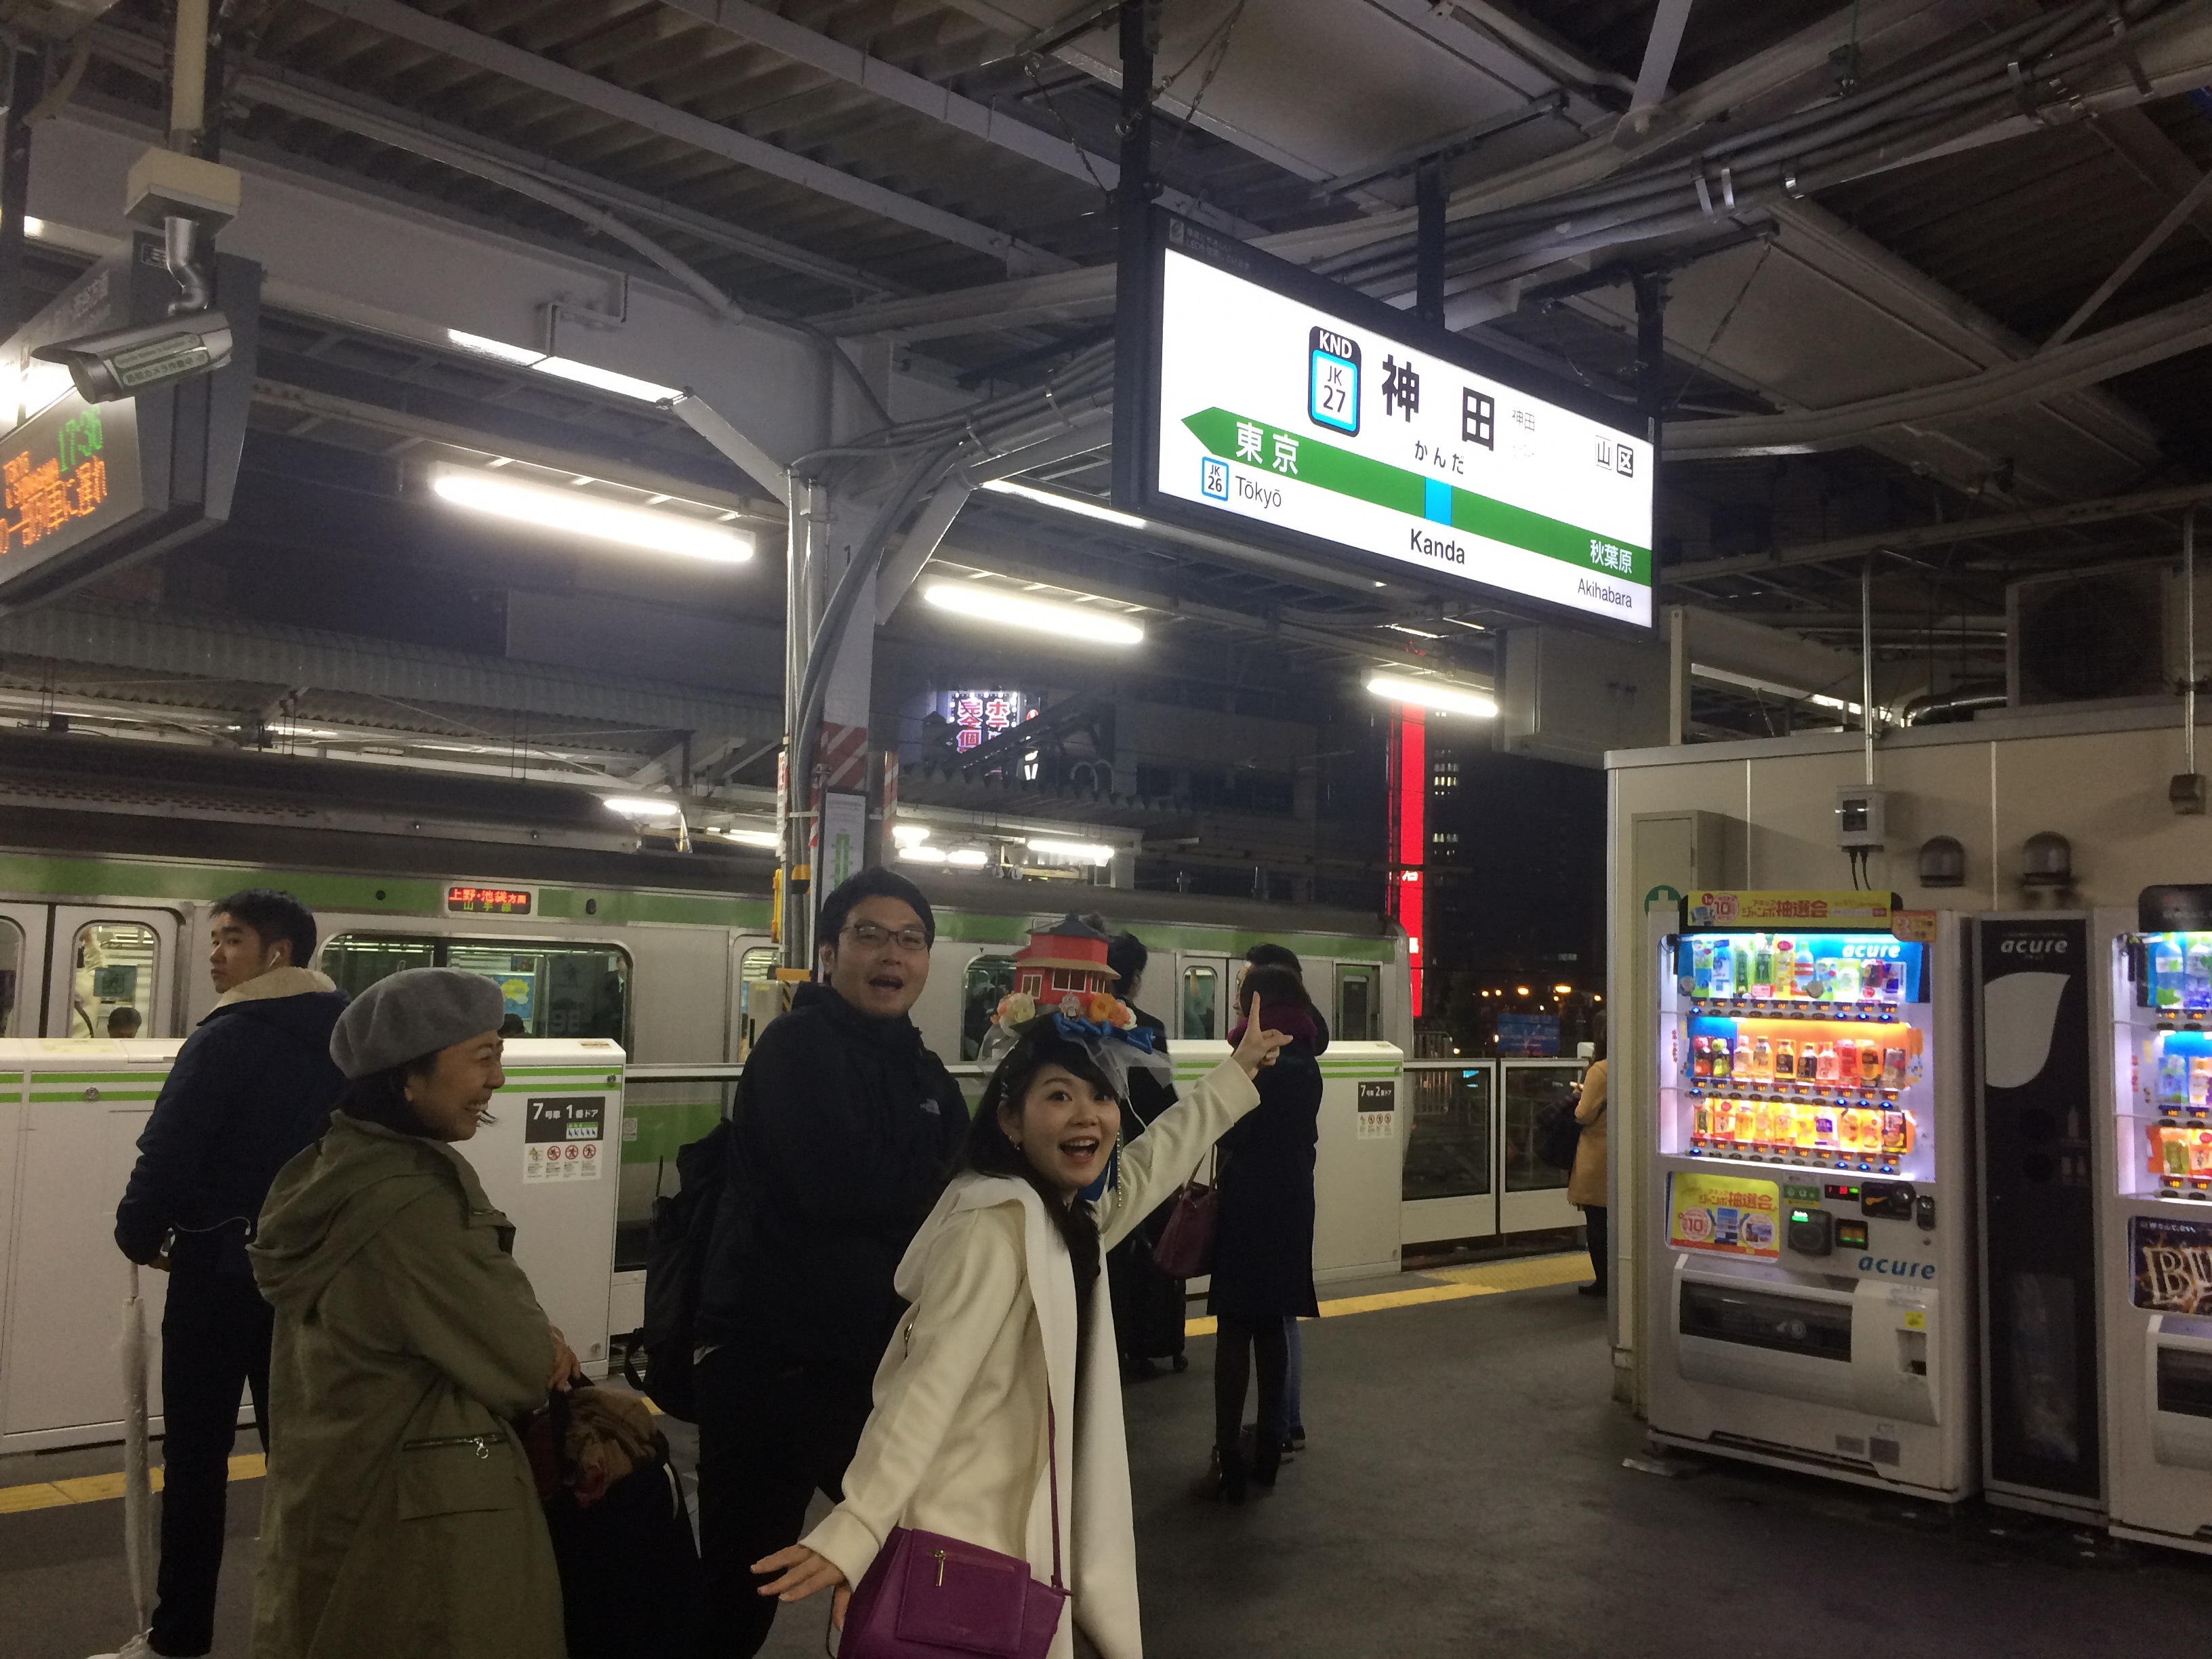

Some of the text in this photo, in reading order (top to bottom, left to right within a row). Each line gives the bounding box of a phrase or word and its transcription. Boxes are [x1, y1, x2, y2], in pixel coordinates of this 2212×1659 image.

[1319, 330, 1353, 359] KND
[1327, 365, 1343, 386] JK
[1323, 384, 1346, 413] 27
[1382, 354, 1495, 451] 神田
[1235, 421, 1299, 475] 東京
[1415, 441, 1465, 475] かんだ
[1208, 476, 1223, 493] 26
[1210, 464, 1221, 476] JK
[1235, 475, 1282, 510] Tōkyō
[1410, 528, 1466, 565] Kanda
[1590, 539, 1633, 575] 秋葉原
[1578, 578, 1633, 609] Akihabara
[958, 699, 982, 753] 完全個
[1842, 944, 1901, 958] acure
[2001, 939, 2068, 954] acure
[1858, 1255, 1936, 1280] acure
